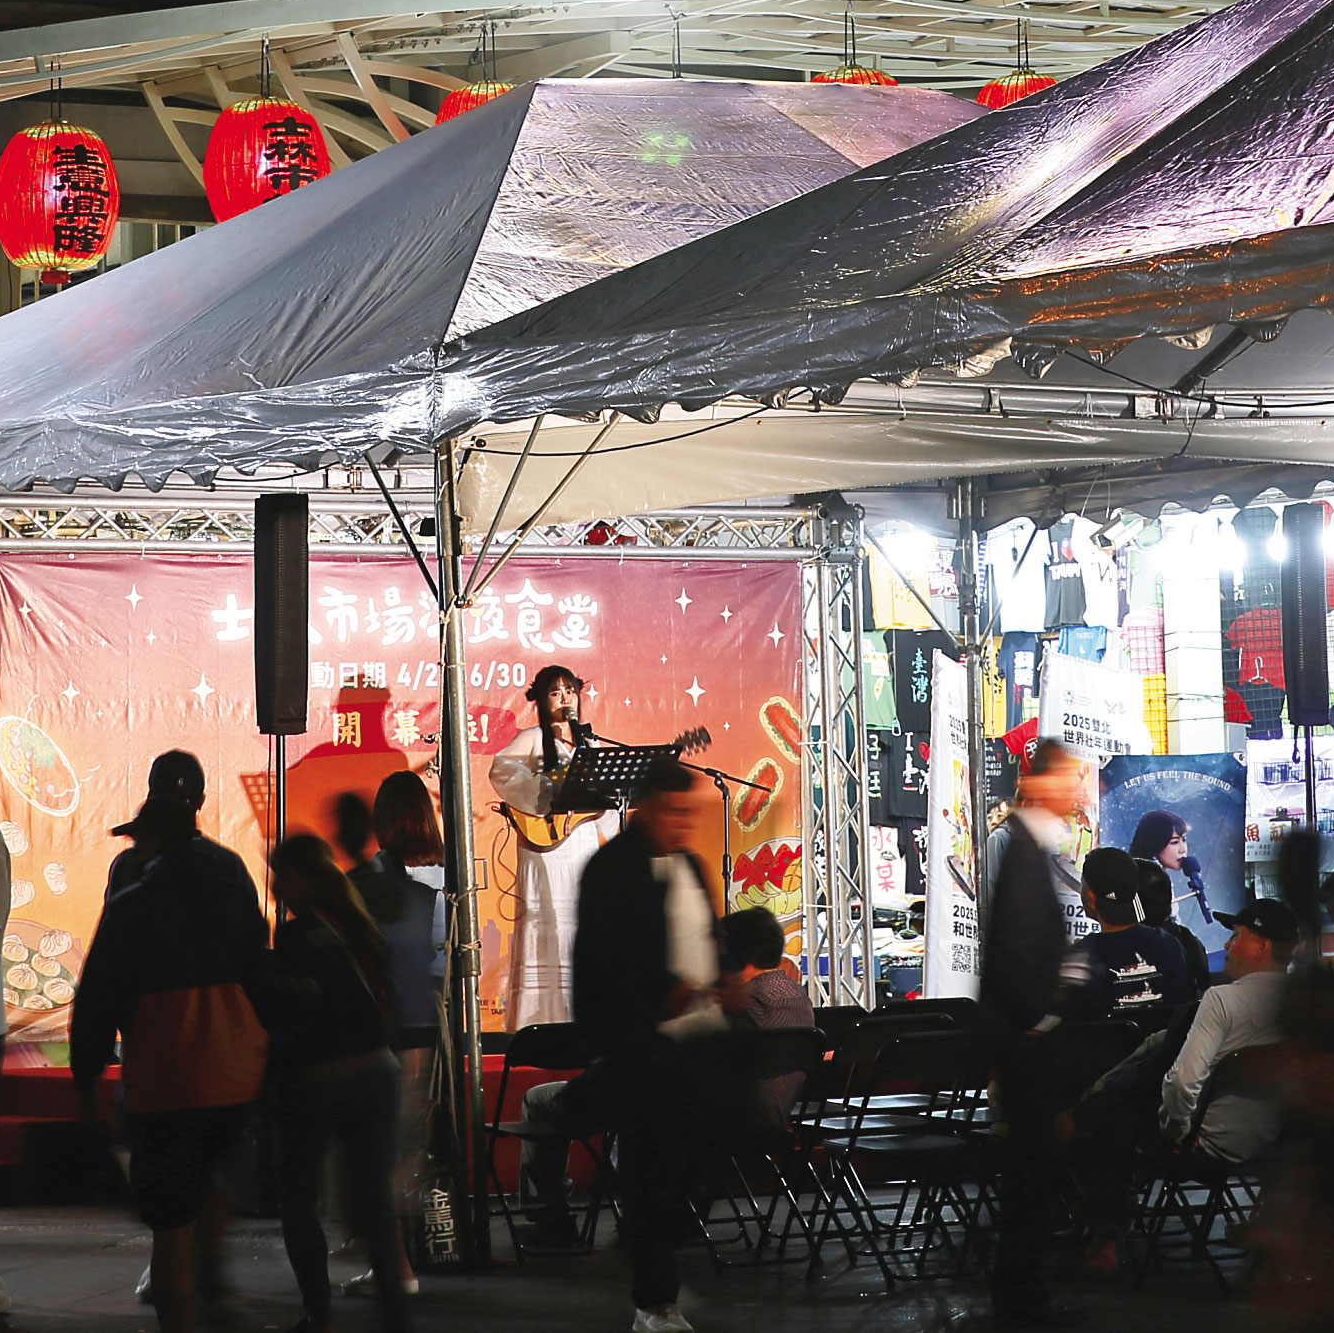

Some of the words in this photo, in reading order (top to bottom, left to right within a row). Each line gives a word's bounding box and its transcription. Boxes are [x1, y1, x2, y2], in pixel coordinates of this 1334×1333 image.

[262, 116, 320, 204] 士林市
[210, 577, 599, 654] 士市場夜食堂
[1123, 776, 1142, 789] LET
[1143, 772, 1156, 783] US
[1157, 770, 1181, 780] FEEL
[1182, 771, 1201, 782] THE
[1202, 774, 1232, 792] SOUND
